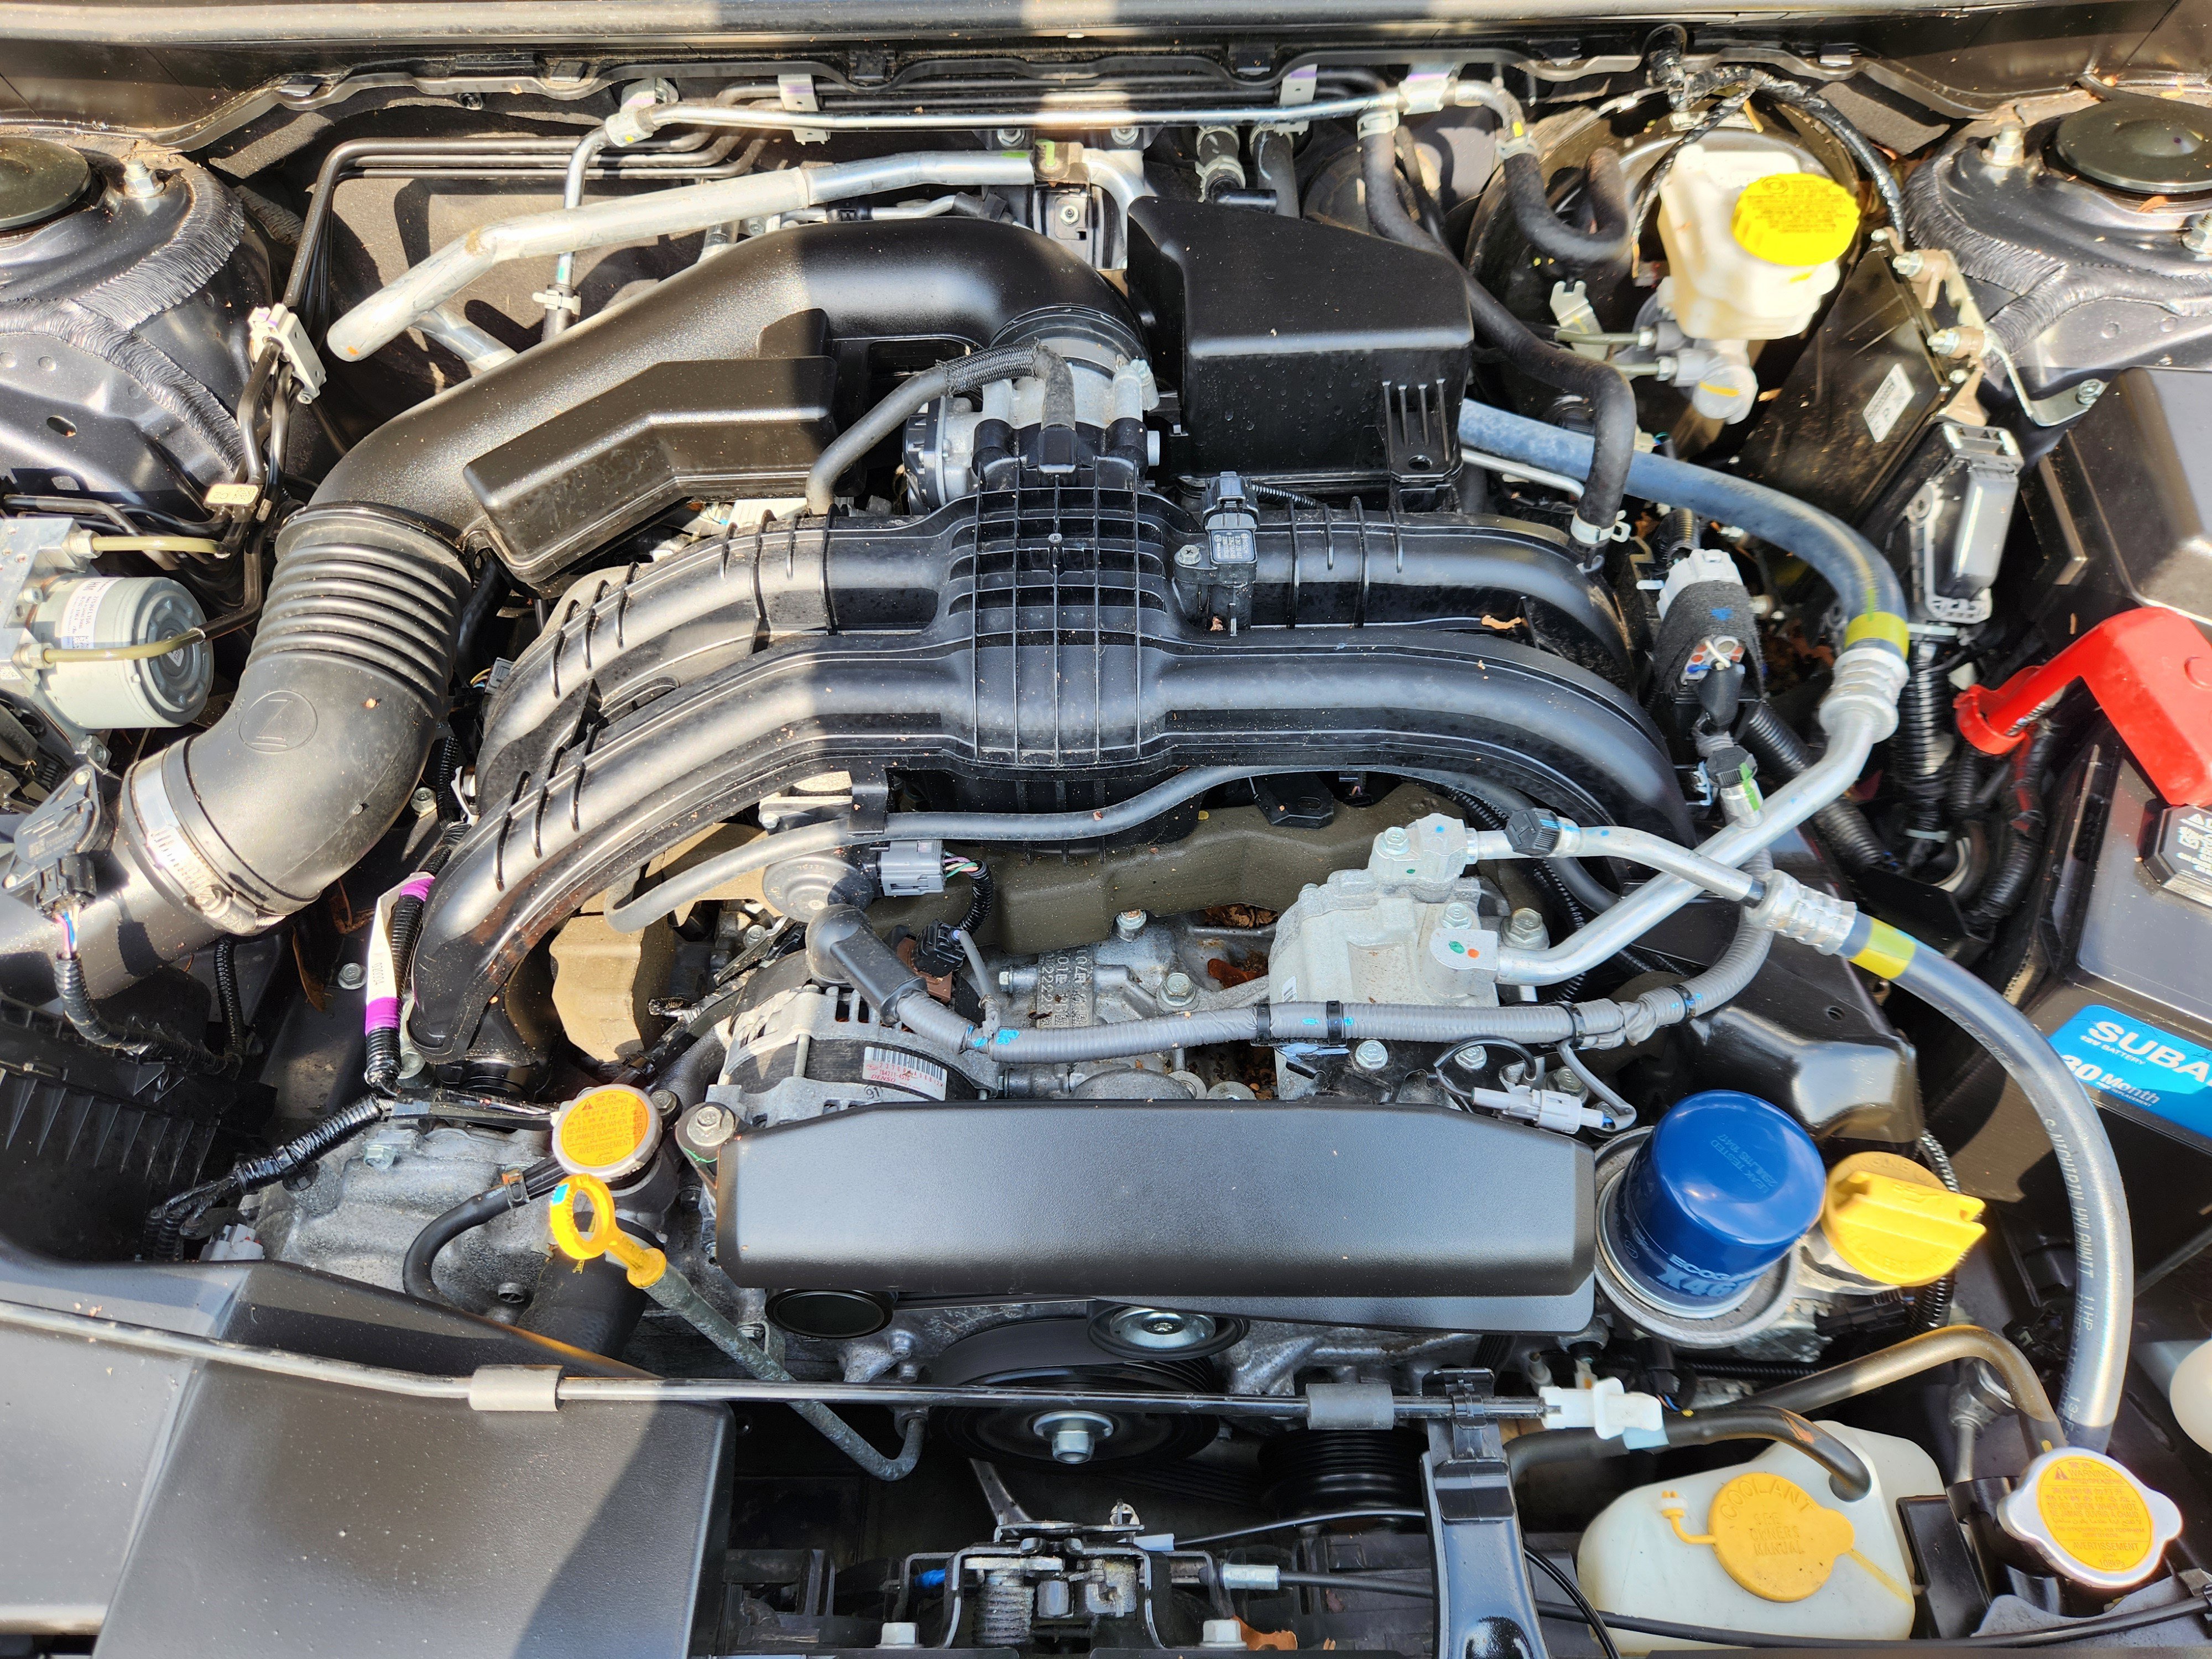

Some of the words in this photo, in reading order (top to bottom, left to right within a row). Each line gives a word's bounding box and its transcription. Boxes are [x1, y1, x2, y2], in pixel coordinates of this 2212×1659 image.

[2088, 1021, 2212, 1087] SUBA
[2101, 1045, 2147, 1065] BATTERY
[871, 1074, 896, 1083] DENSO
[2101, 1073, 2161, 1104] Month
[596, 1098, 629, 1108] WARNING
[2111, 1089, 2152, 1107] REPLACEMENT
[566, 1126, 587, 1135] NEVER
[589, 1122, 607, 1130] OPEN
[608, 1118, 628, 1126] WHEN
[578, 1139, 632, 1155] AVERTISSEMENT
[1710, 1140, 1745, 1171] TESTED
[1743, 1170, 1770, 1193] LEAK
[2068, 1469, 2112, 1478] WARNING
[1720, 1477, 1817, 1521] COOLANT
[2075, 1503, 2094, 1511] OPEN
[1754, 1512, 1781, 1525] SEE
[1751, 1525, 1801, 1541] OWNERS
[1753, 1539, 1806, 1556] MANUAL
[2073, 1542, 2138, 1551] AVERTISSEMENT
[2099, 1559, 2126, 1568] 108kPa
